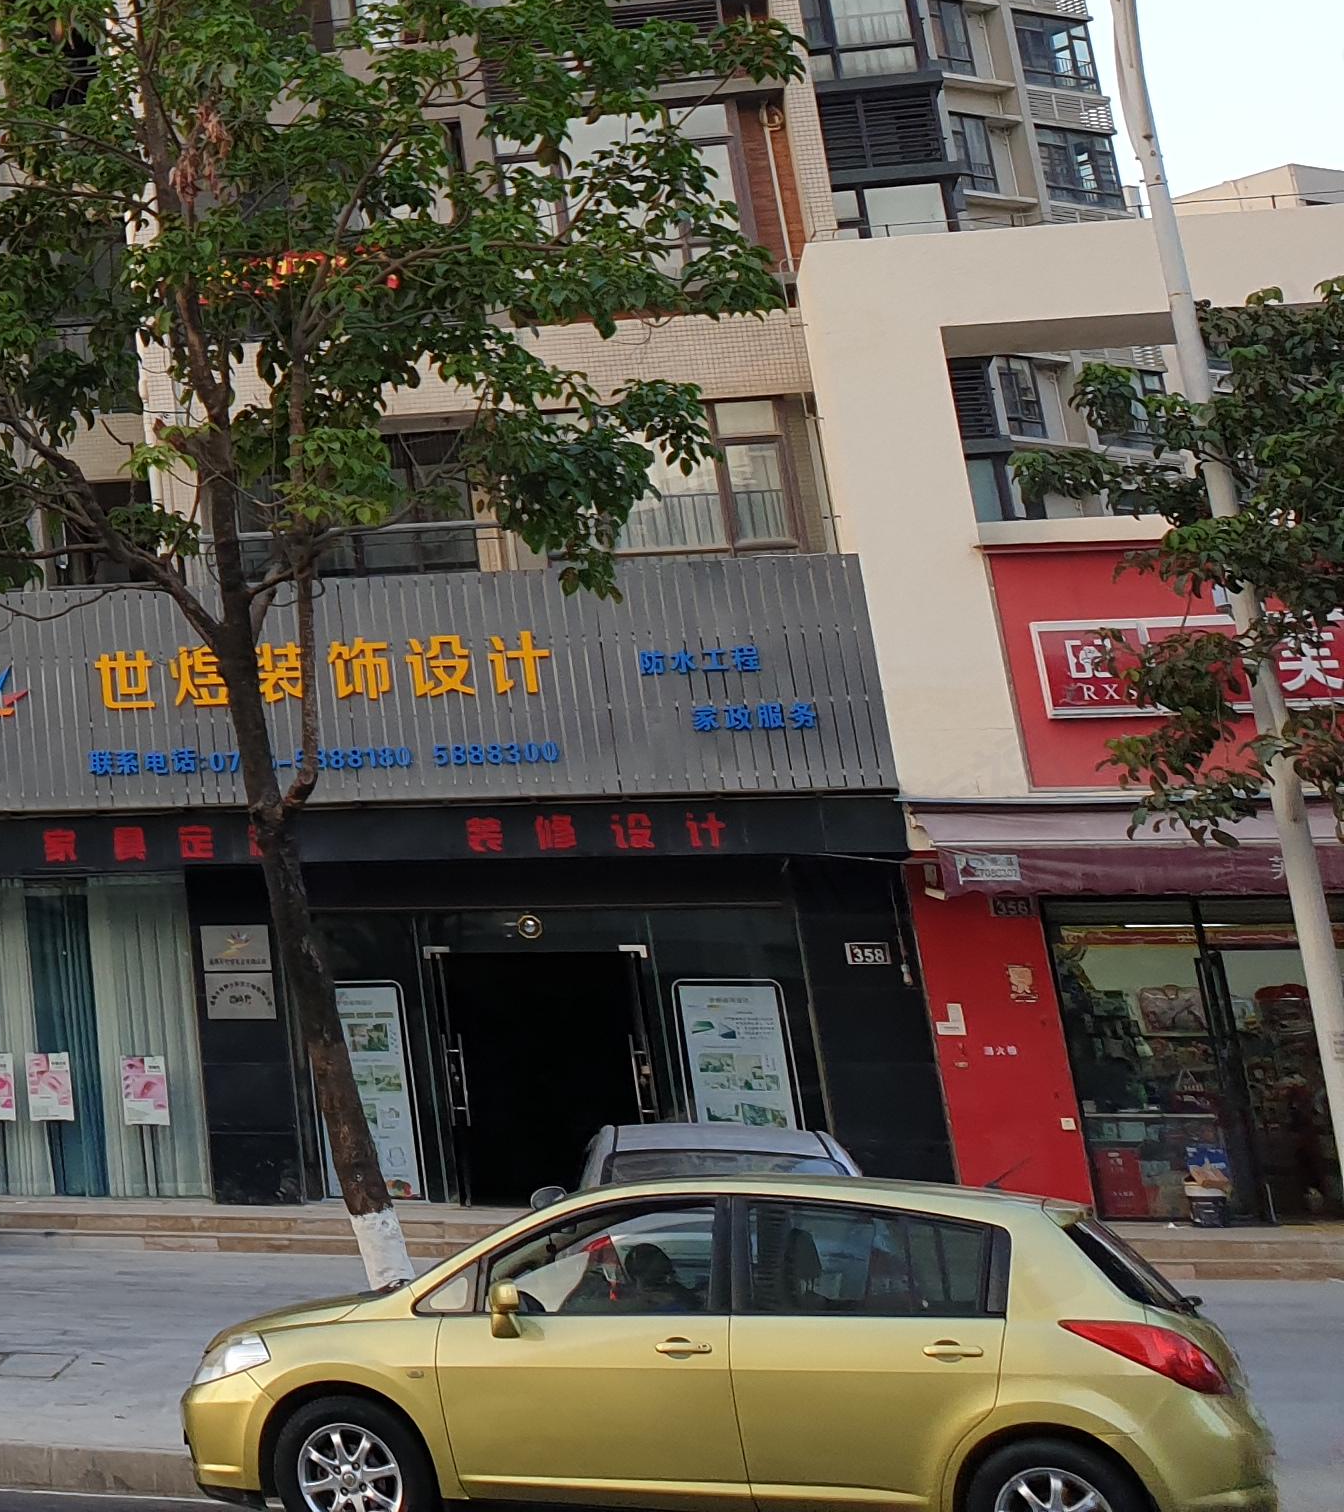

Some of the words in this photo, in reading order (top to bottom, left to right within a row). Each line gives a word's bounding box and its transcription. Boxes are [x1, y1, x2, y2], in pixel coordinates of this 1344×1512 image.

[638, 644, 763, 677] 防水工程
[690, 702, 819, 733] 家政服务
[432, 741, 560, 767] 5888300
[43, 824, 264, 864] 家具定
[465, 811, 728, 855] 装修设计
[853, 948, 885, 964] 358
